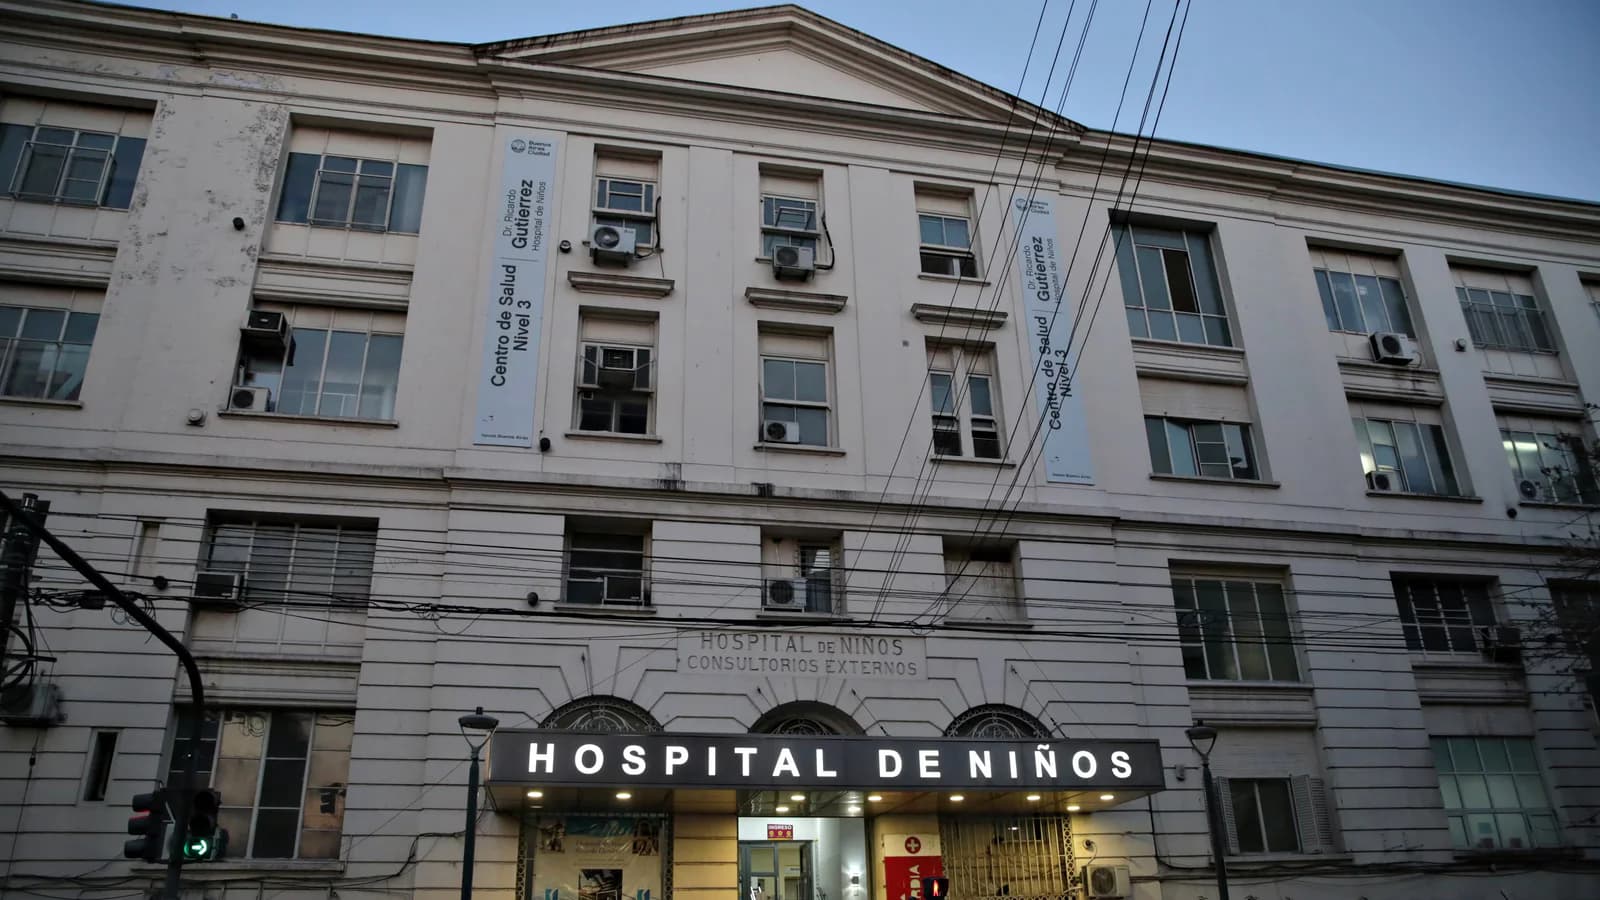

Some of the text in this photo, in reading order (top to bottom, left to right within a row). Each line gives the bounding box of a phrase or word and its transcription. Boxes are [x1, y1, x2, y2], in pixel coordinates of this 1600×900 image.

[502, 188, 517, 237] Dr. Ricardo
[511, 179, 533, 249] Gutierrez
[532, 181, 546, 252] Hospital de Niños
[1023, 245, 1036, 290] Dr. Ricardo
[1032, 236, 1050, 302] Gutierrez
[1047, 238, 1055, 259] Niños
[1049, 261, 1057, 271] de
[490, 264, 517, 387] Centro de Salud
[513, 300, 532, 351] Nivel 3
[1034, 316, 1062, 430] Centro de Salud
[1055, 350, 1073, 397] Nivel 3
[687, 655, 917, 676] CONSULTORIOS EXTERNOS
[701, 631, 903, 656] HOSPITAL DE NIÑOS
[528, 742, 1132, 779] HOSPITAL DE NIÑOS
